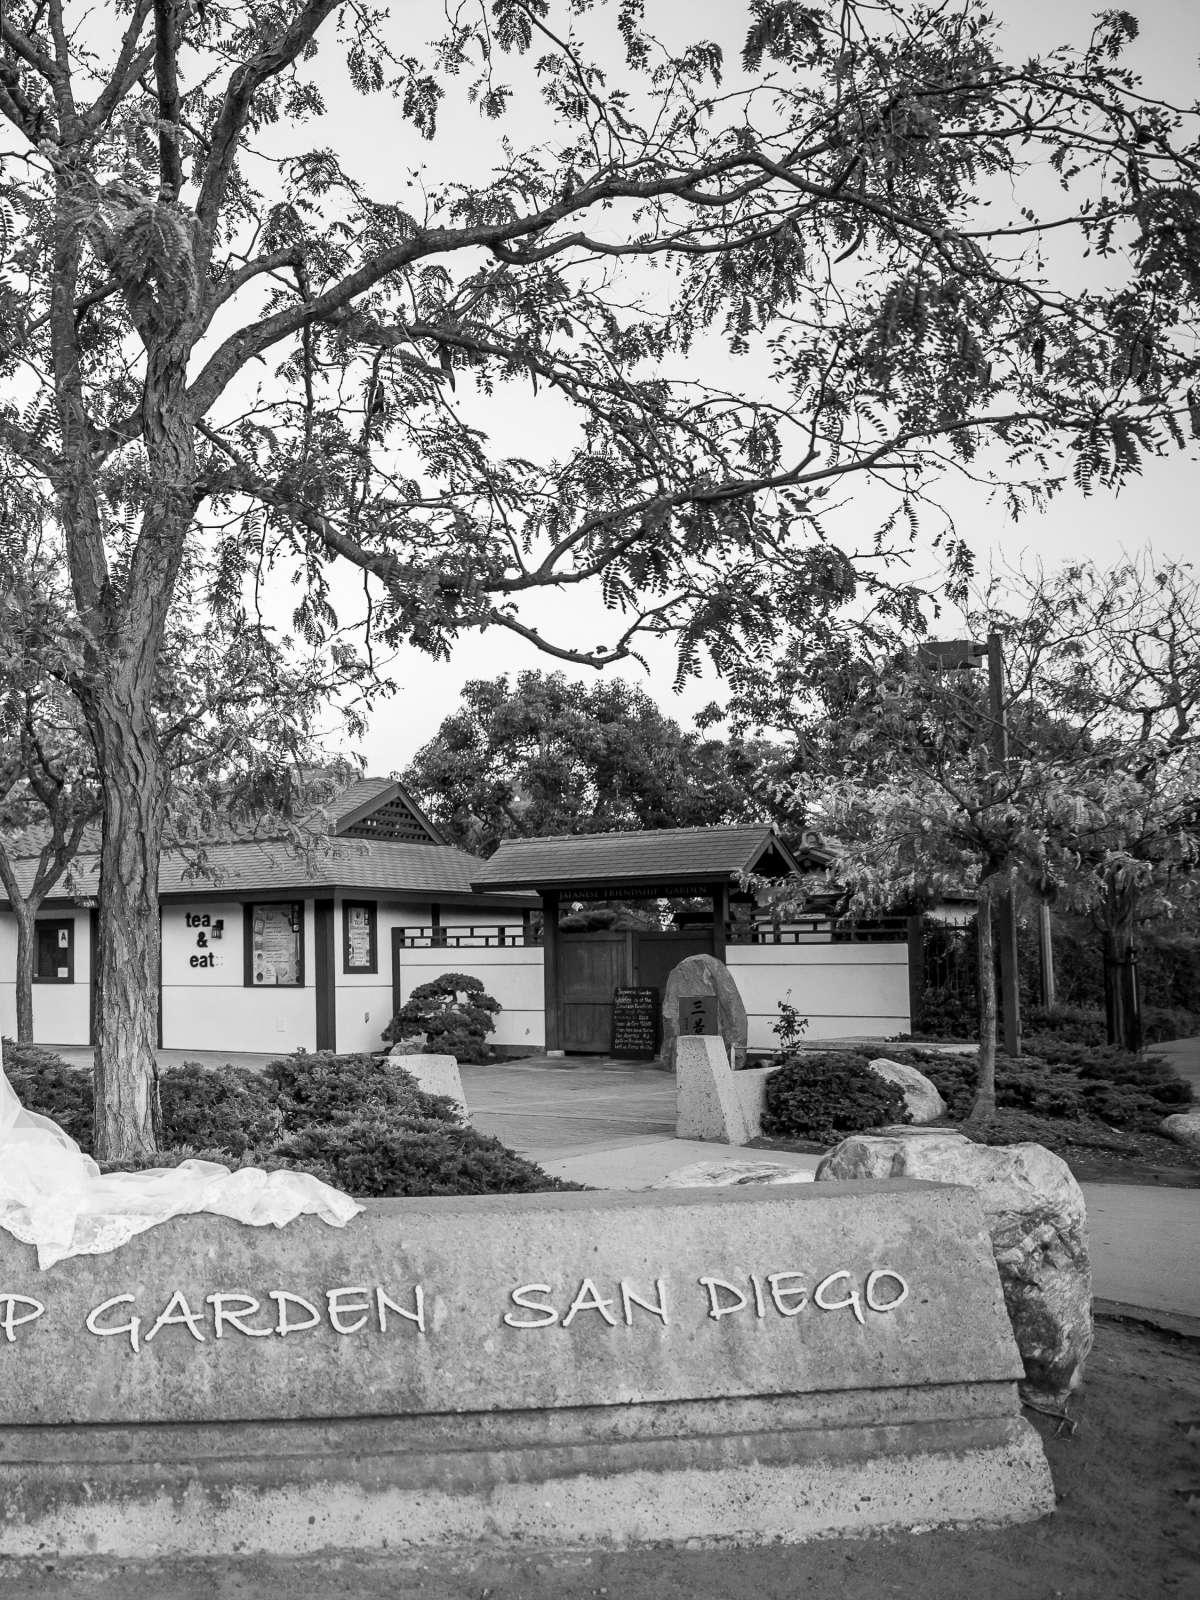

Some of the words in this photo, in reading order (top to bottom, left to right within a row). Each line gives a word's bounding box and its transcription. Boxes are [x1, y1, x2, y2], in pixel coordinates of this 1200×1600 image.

[185, 912, 211, 928] tea
[60, 931, 67, 942] A
[196, 931, 208, 948] &
[189, 952, 215, 968] eat
[86, 1285, 427, 1352] GARDEN
[503, 1276, 671, 1328] SAN
[699, 1269, 909, 1323] DIEGO
